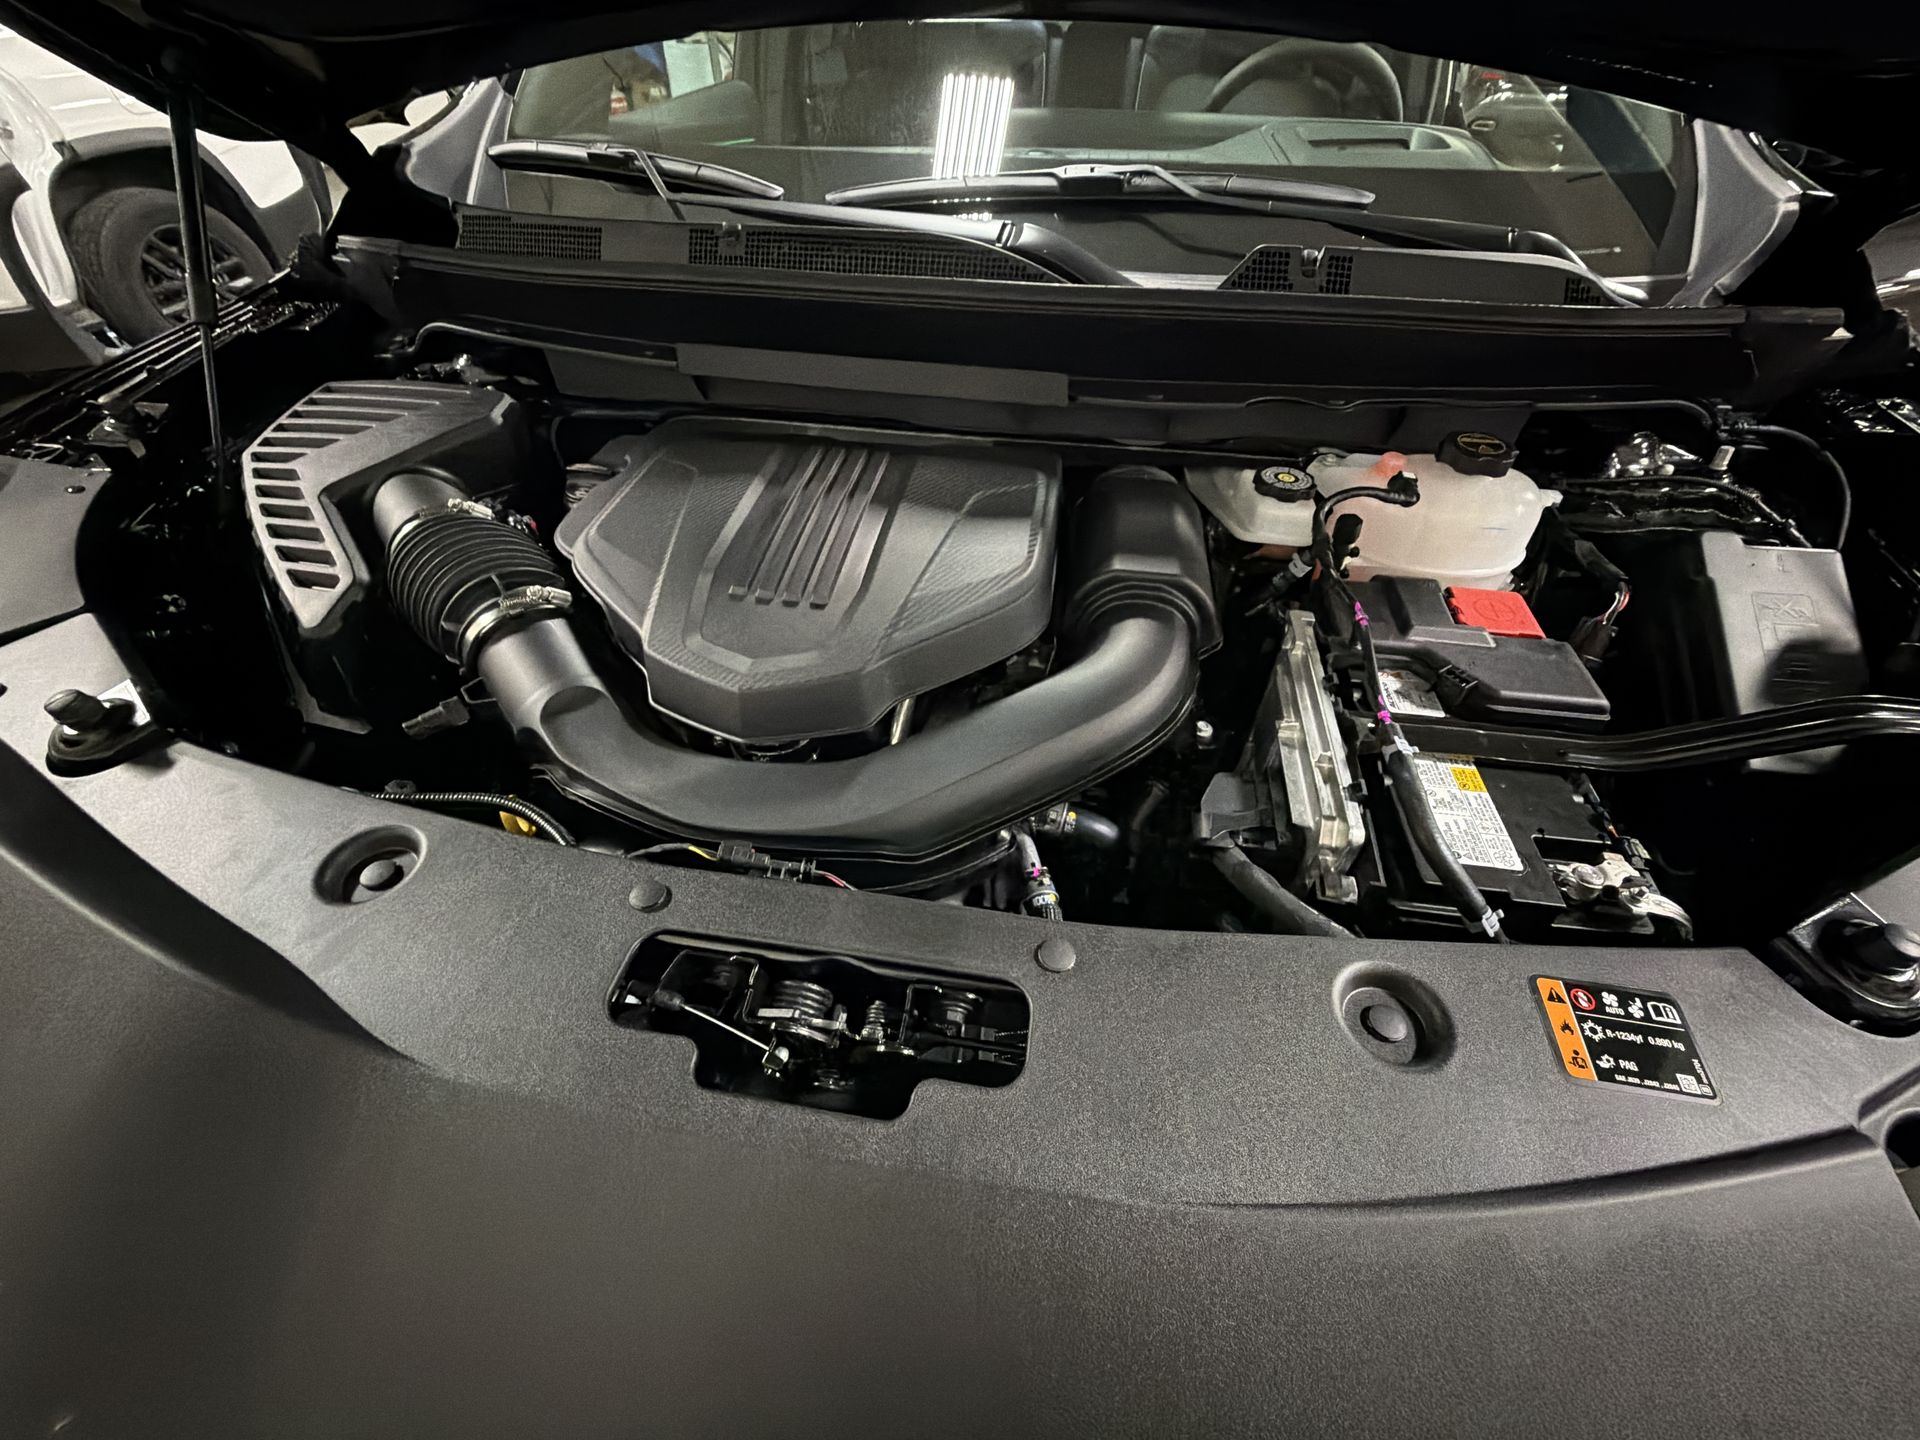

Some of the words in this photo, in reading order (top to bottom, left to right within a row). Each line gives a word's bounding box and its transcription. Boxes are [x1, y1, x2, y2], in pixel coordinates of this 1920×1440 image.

[1605, 1006, 1624, 1015] AUTO
[1605, 1029, 1644, 1044] R-1234yf
[1672, 1040, 1686, 1052] kg
[1619, 1059, 1639, 1071] PAG
